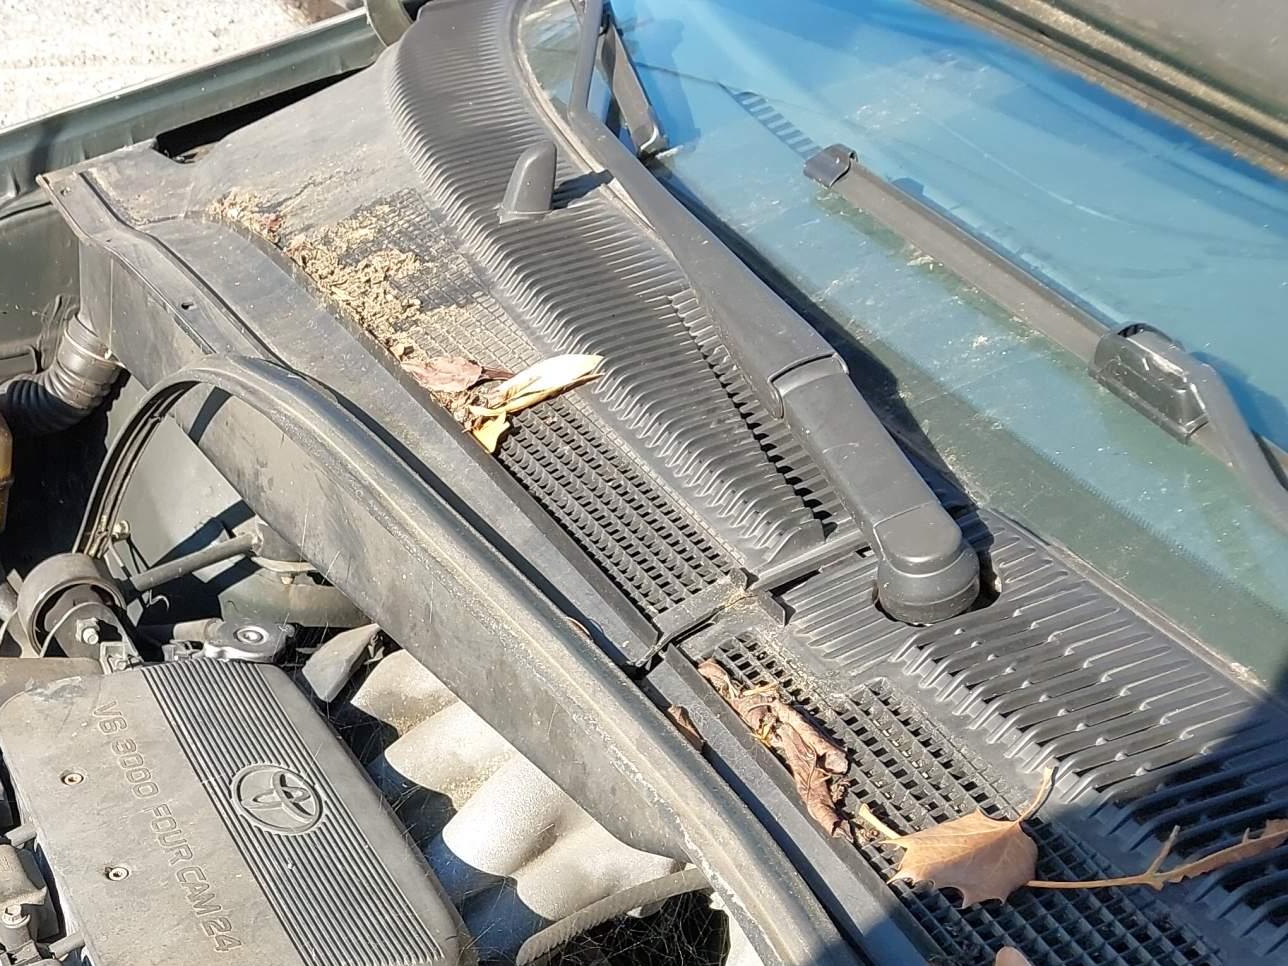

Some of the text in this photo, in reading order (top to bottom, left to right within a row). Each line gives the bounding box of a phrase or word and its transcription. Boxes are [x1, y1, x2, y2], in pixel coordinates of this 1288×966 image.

[92, 700, 243, 952] V6 3000 FOUR CAM 24
